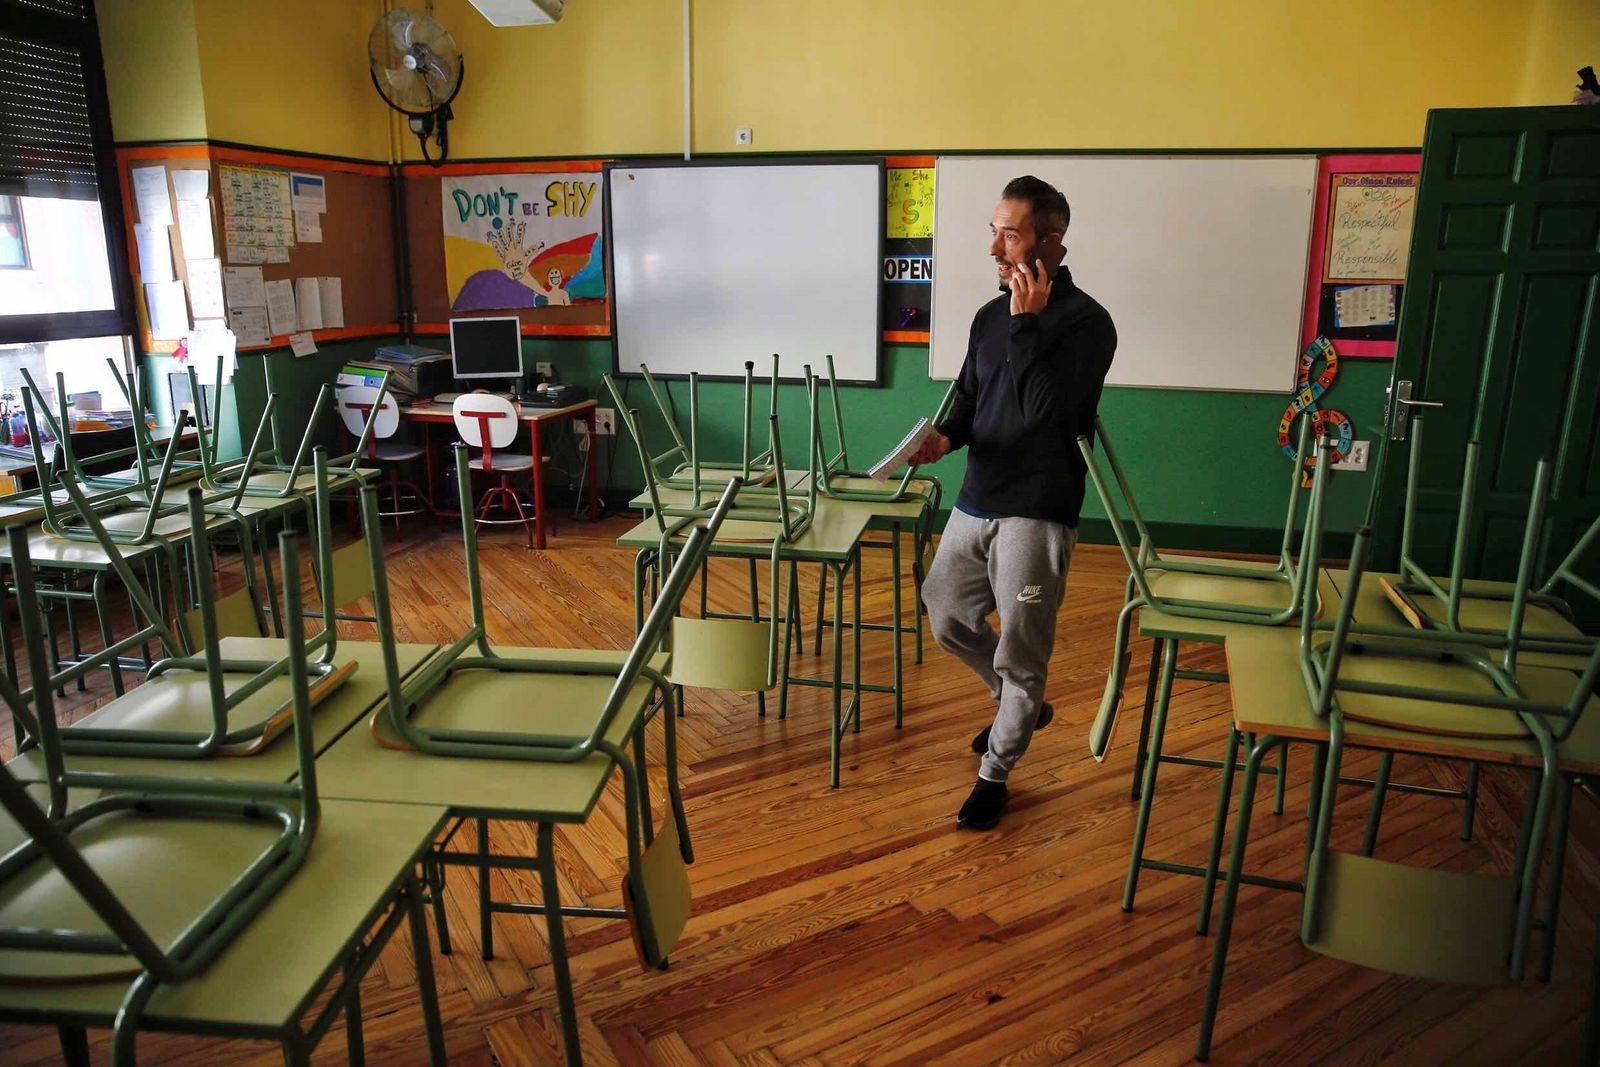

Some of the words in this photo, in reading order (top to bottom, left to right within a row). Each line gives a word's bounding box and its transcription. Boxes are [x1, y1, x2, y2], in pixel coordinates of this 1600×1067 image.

[452, 187, 519, 222] DON'T
[522, 203, 540, 216] BE
[545, 181, 598, 217] SHY
[902, 199, 920, 224] S
[884, 259, 932, 280] OPEN
[1022, 585, 1042, 594] NIKE
